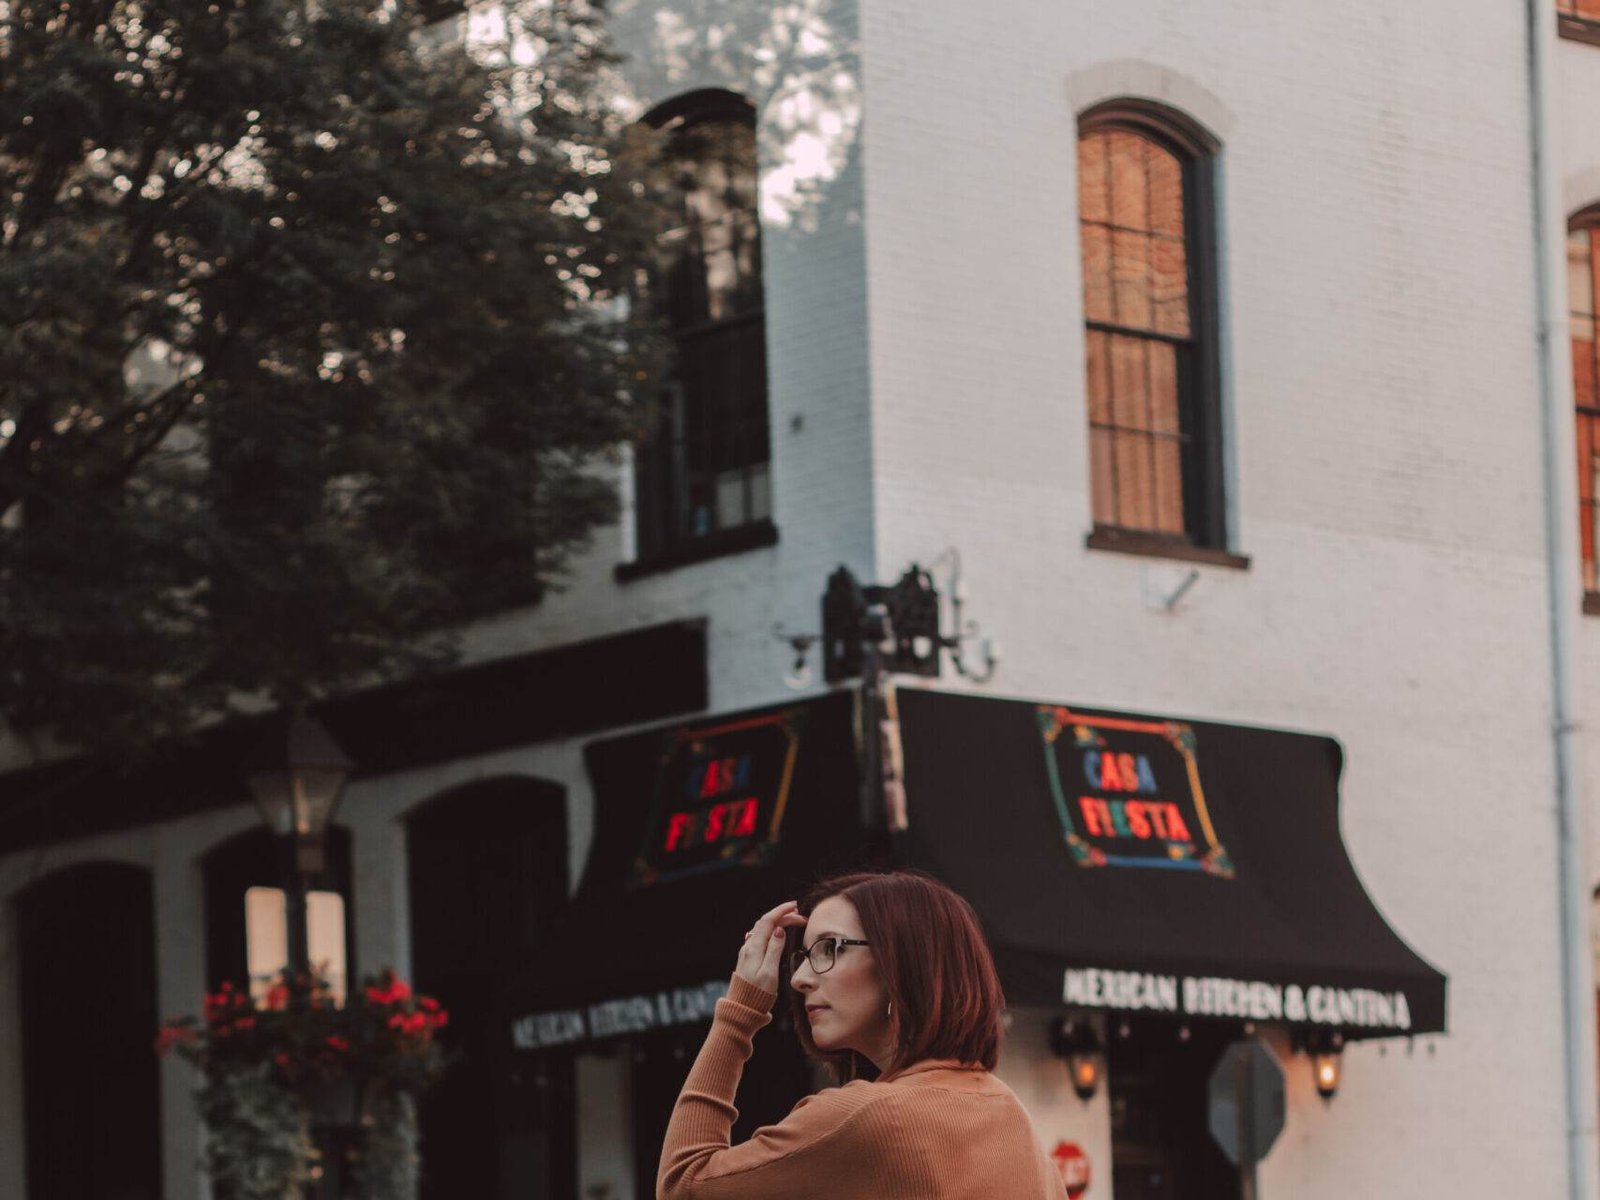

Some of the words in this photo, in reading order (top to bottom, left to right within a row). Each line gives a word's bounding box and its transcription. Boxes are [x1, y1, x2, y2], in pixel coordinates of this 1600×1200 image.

[1083, 749, 1158, 793] CASA
[1078, 796, 1192, 842] FIESTA
[1063, 968, 1177, 1011] MEXICAN
[1182, 976, 1282, 1020] KITCHEN
[1284, 983, 1306, 1022] &
[1306, 985, 1412, 1030] CANTINA
